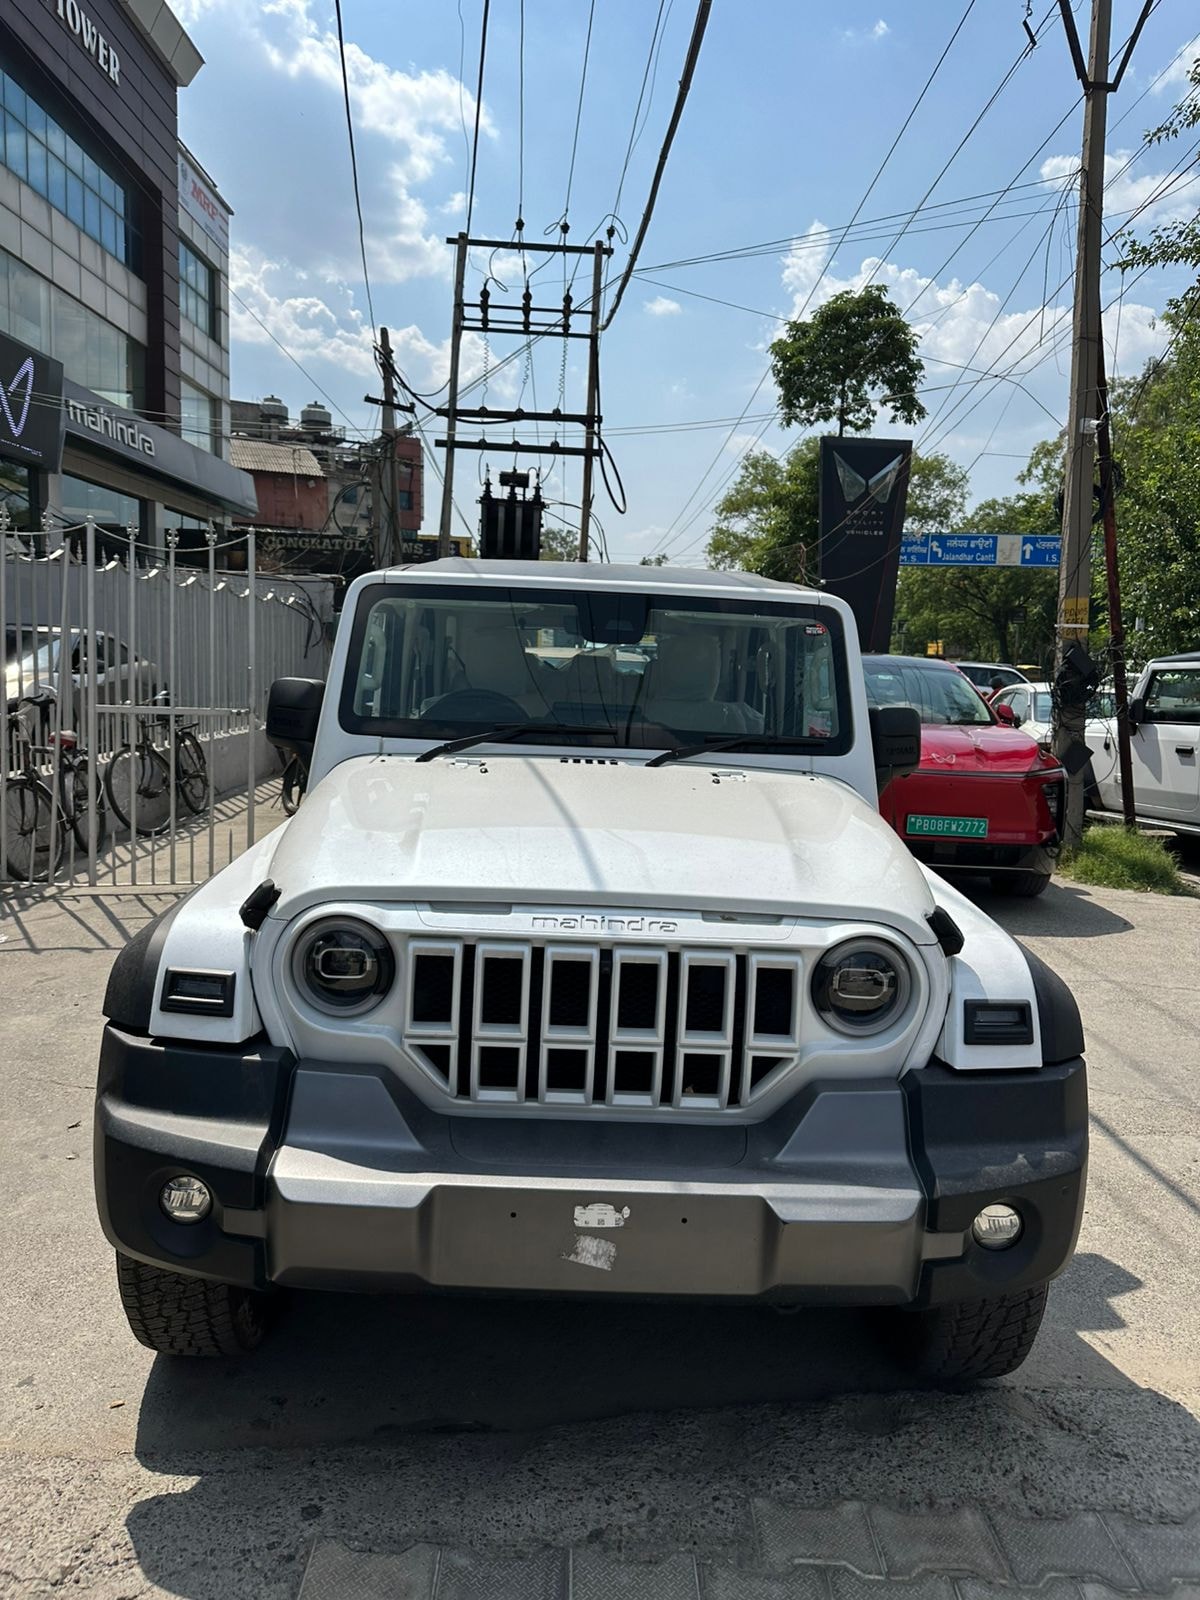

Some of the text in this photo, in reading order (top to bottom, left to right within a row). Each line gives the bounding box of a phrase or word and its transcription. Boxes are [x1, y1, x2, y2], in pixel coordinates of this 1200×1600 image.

[69, 399, 155, 456] mahindra
[942, 552, 974, 561] Jalandhar
[915, 818, 986, 834] PB08FW2772
[531, 915, 678, 933] mahindra
